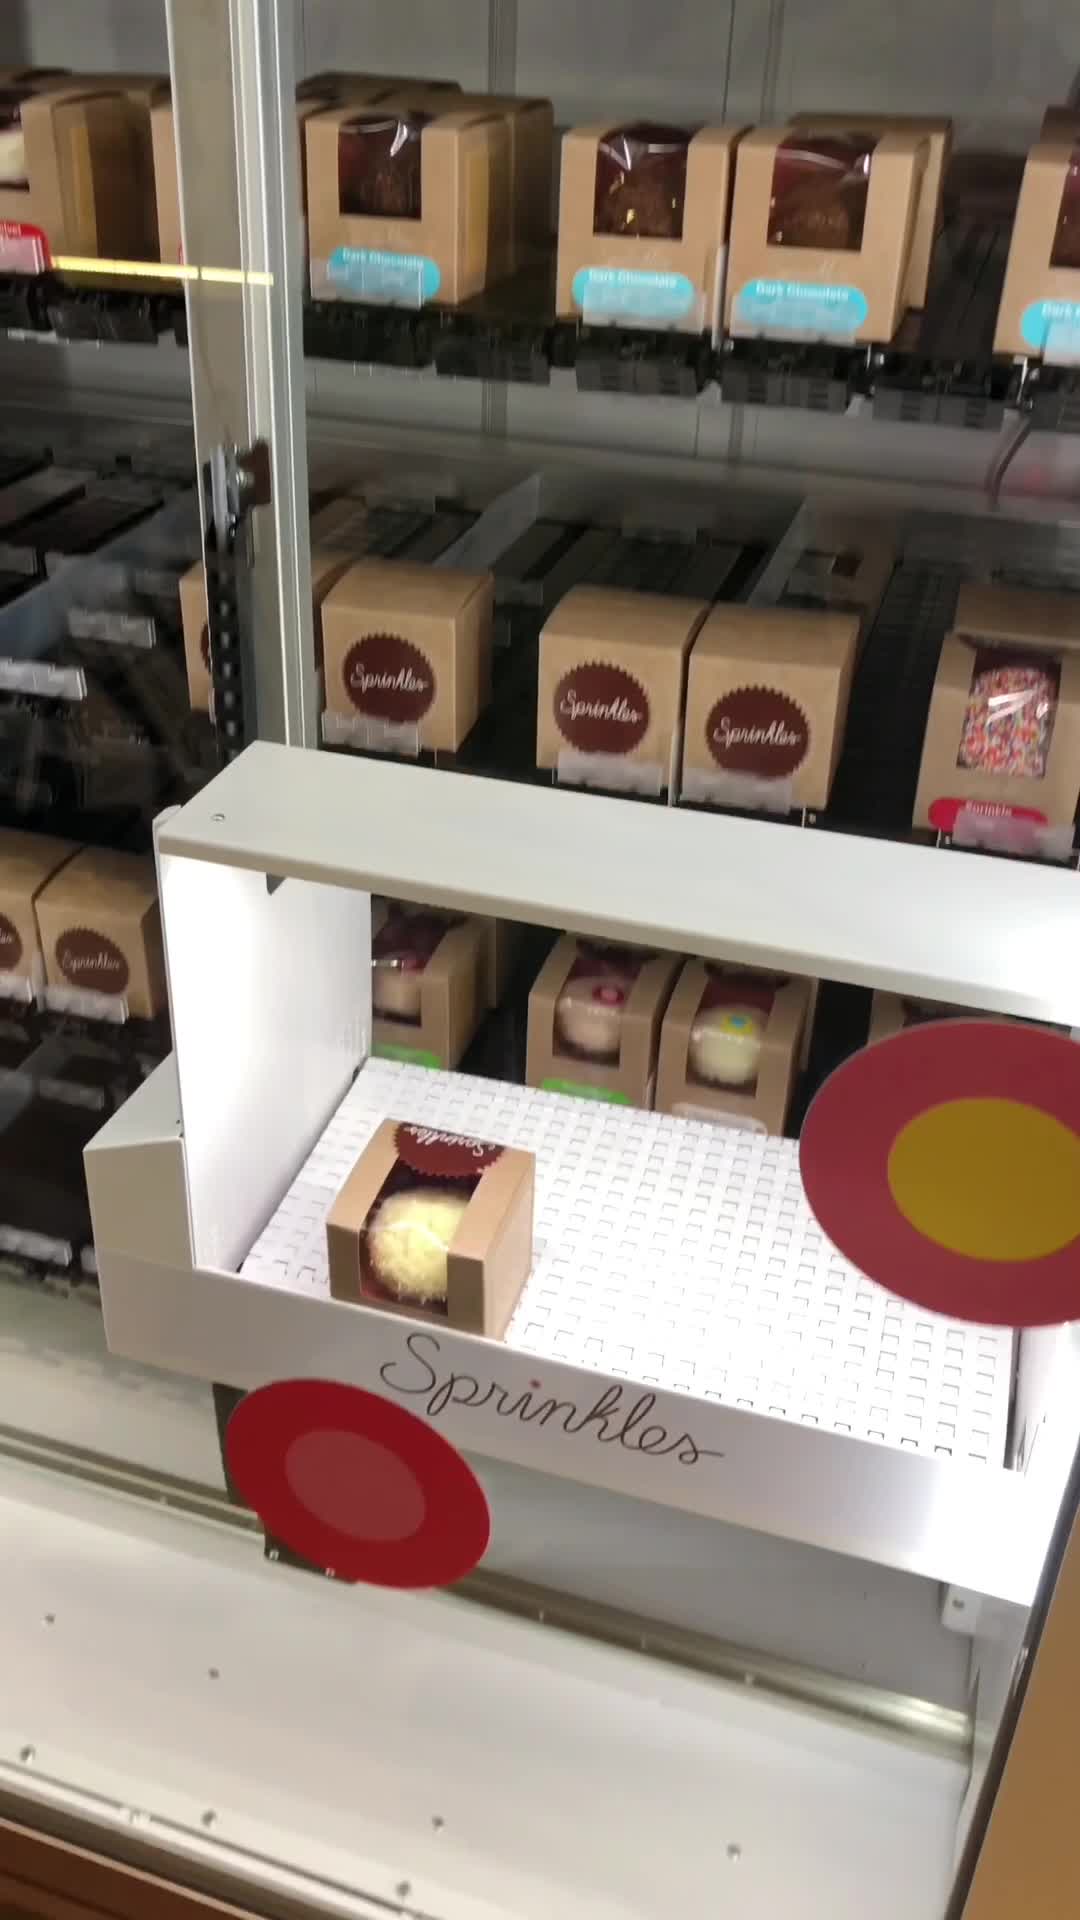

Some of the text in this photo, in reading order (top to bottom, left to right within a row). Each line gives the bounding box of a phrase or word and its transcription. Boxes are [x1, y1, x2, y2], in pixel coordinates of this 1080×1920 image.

[350, 663, 429, 693] Sprinkles
[560, 689, 643, 724] Sprinkles
[713, 716, 801, 750] Sprinkles
[379, 1332, 725, 1465] Sprinkles
